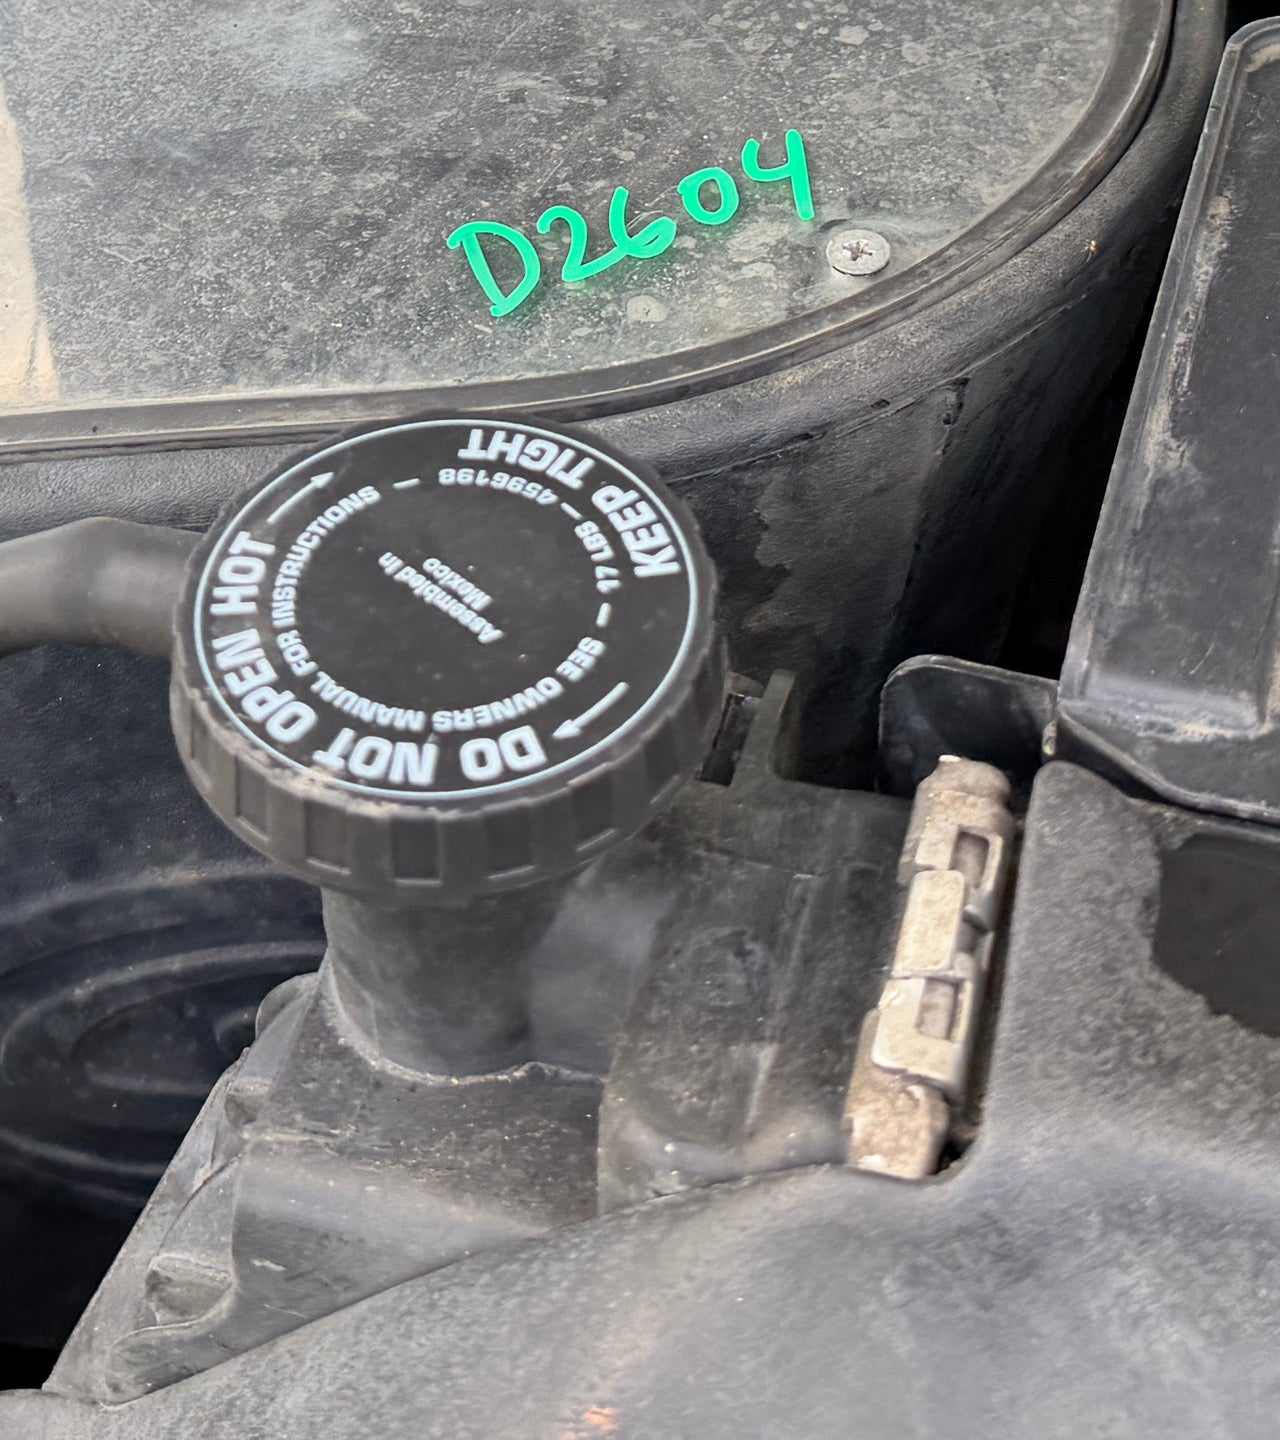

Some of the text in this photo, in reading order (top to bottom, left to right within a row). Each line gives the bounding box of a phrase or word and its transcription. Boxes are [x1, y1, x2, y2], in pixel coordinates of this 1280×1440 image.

[447, 128, 815, 317] D2604
[438, 468, 558, 505] 4596198
[458, 429, 681, 577] KEEP TIGHT
[574, 521, 614, 562] LBS
[272, 485, 606, 732] SEE OWNERS MANUAL FOR INSTRUCTIONS
[393, 565, 504, 643] Assembled
[423, 558, 492, 611] Mexico
[210, 531, 548, 786] DO NOT OPEN HOT
